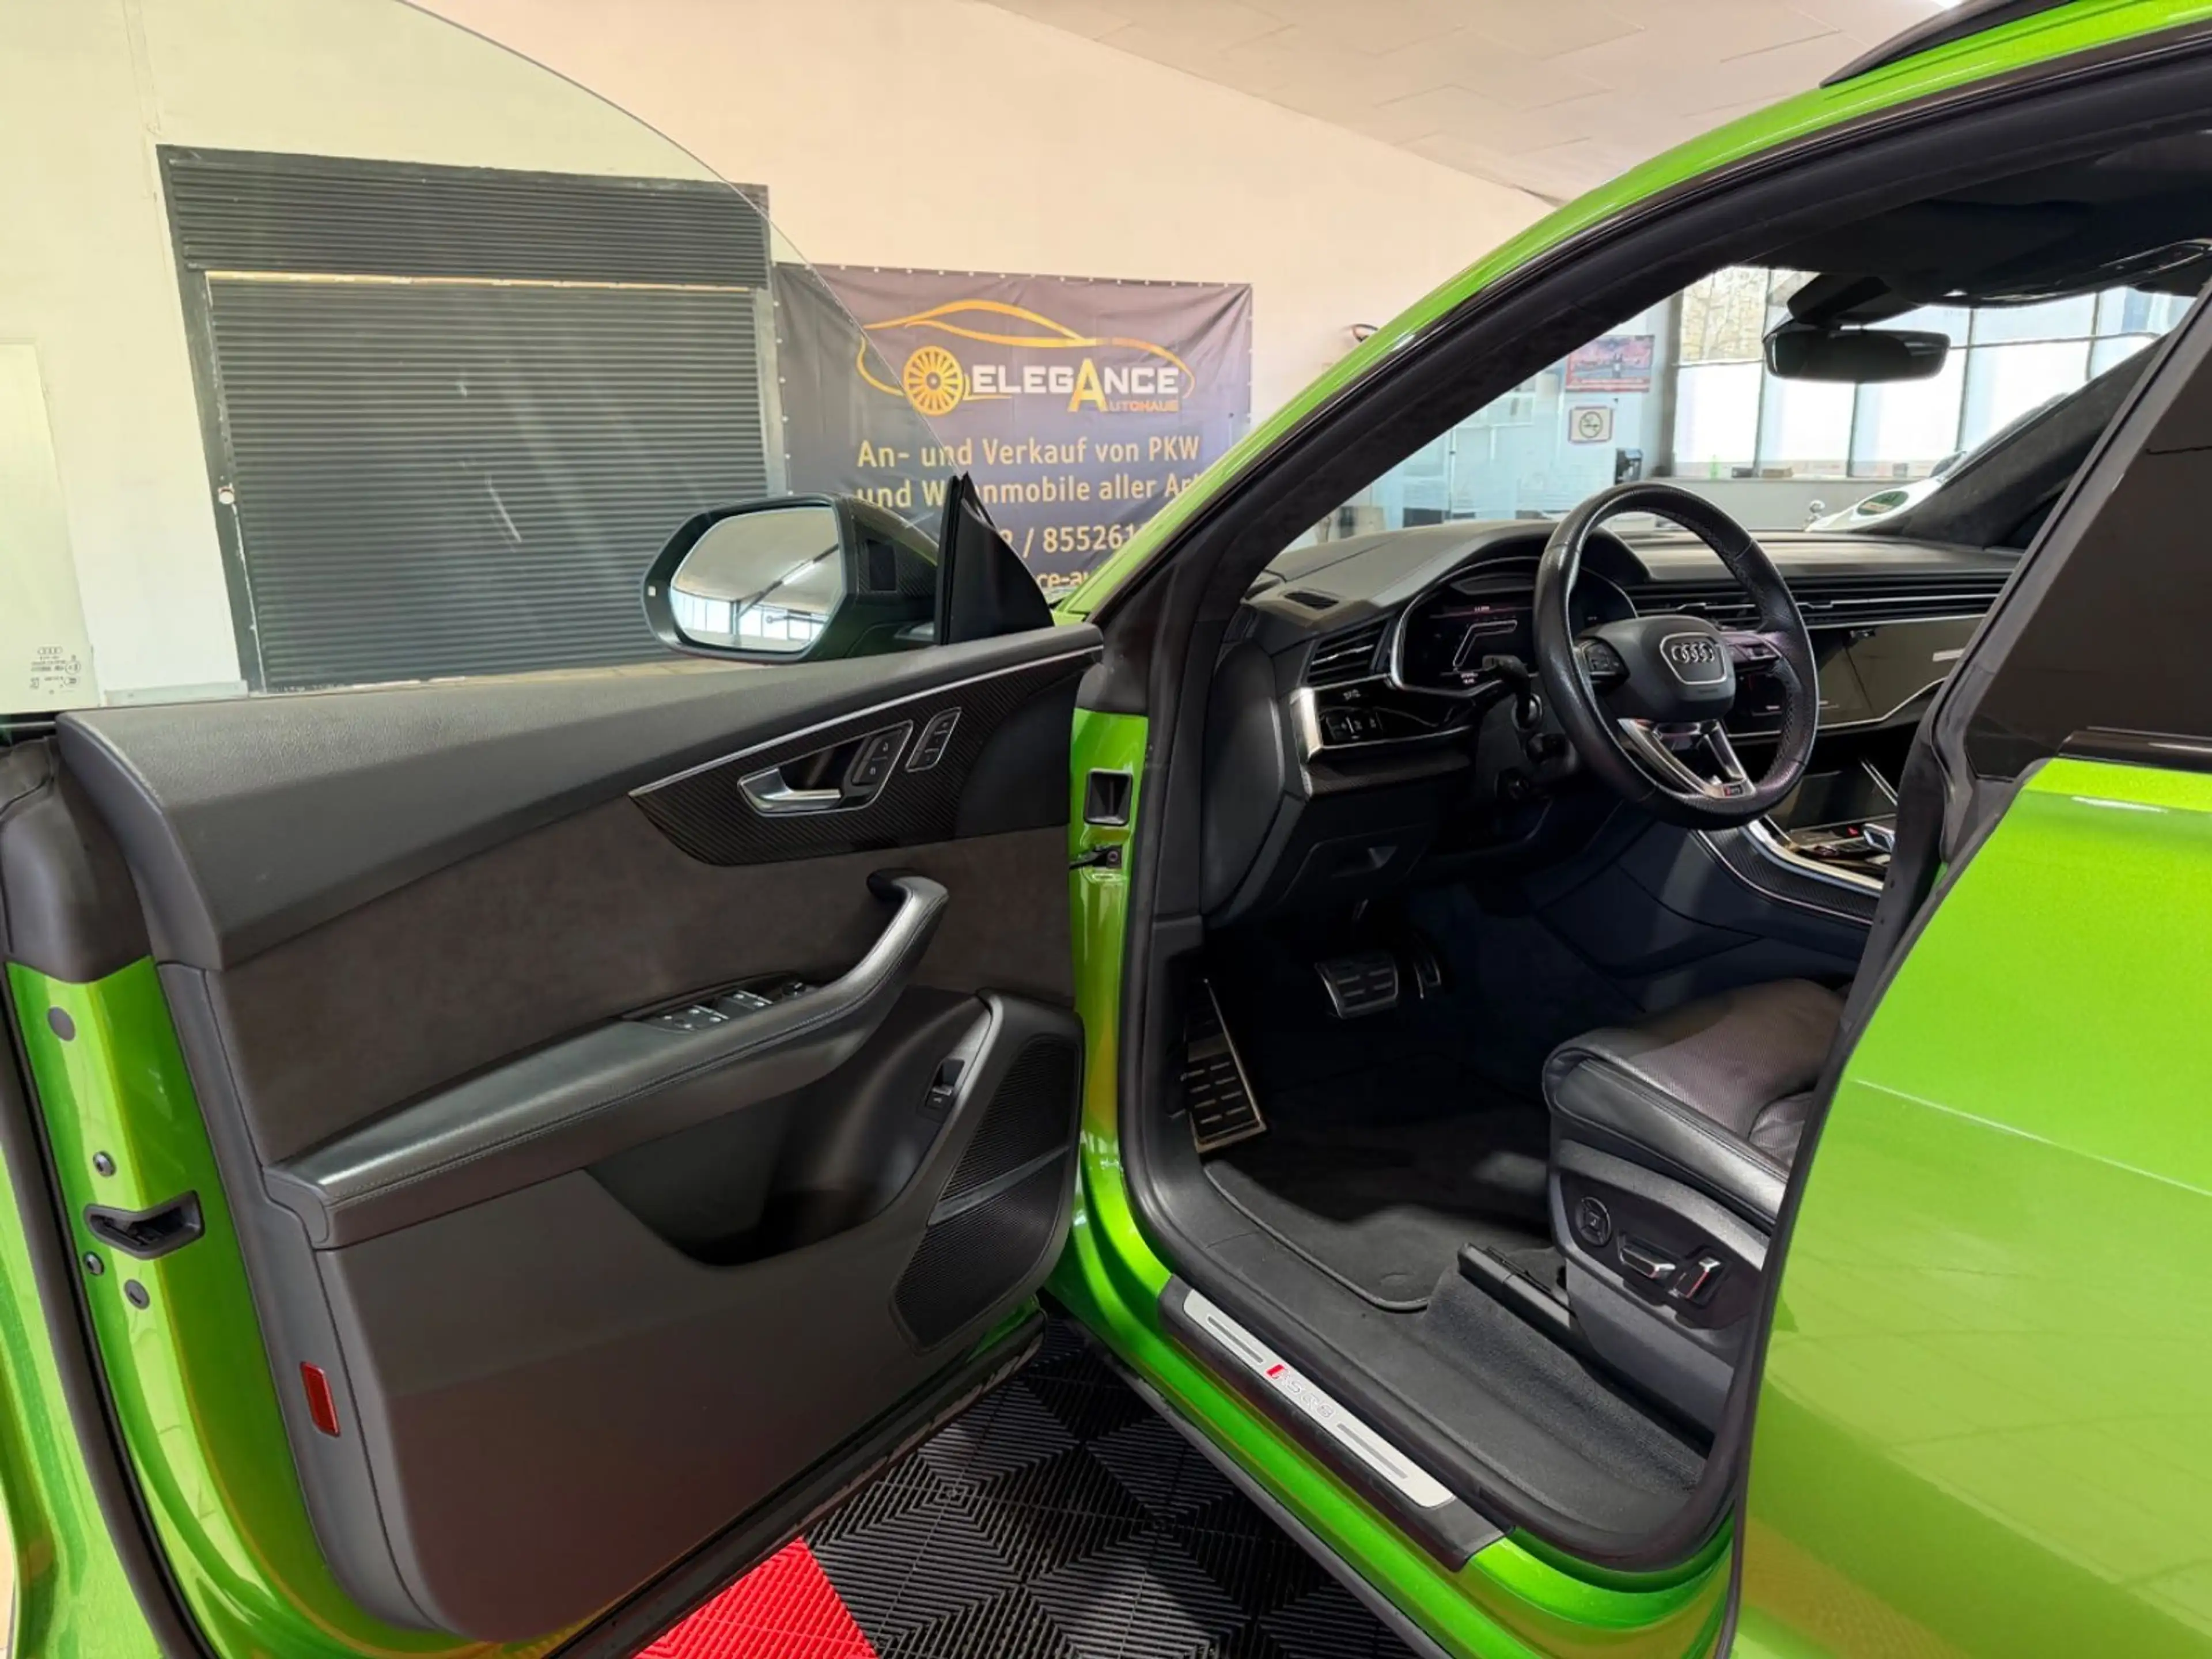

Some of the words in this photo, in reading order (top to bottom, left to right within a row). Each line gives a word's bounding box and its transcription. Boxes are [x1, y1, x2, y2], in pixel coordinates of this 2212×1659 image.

[972, 358, 1179, 411] ELEGANCE
[857, 440, 910, 467] An-
[921, 437, 972, 467] und
[982, 436, 1088, 465] Verkauf
[1095, 443, 1139, 463] von
[1149, 435, 1199, 461] PKW
[1099, 473, 1157, 501] aller
